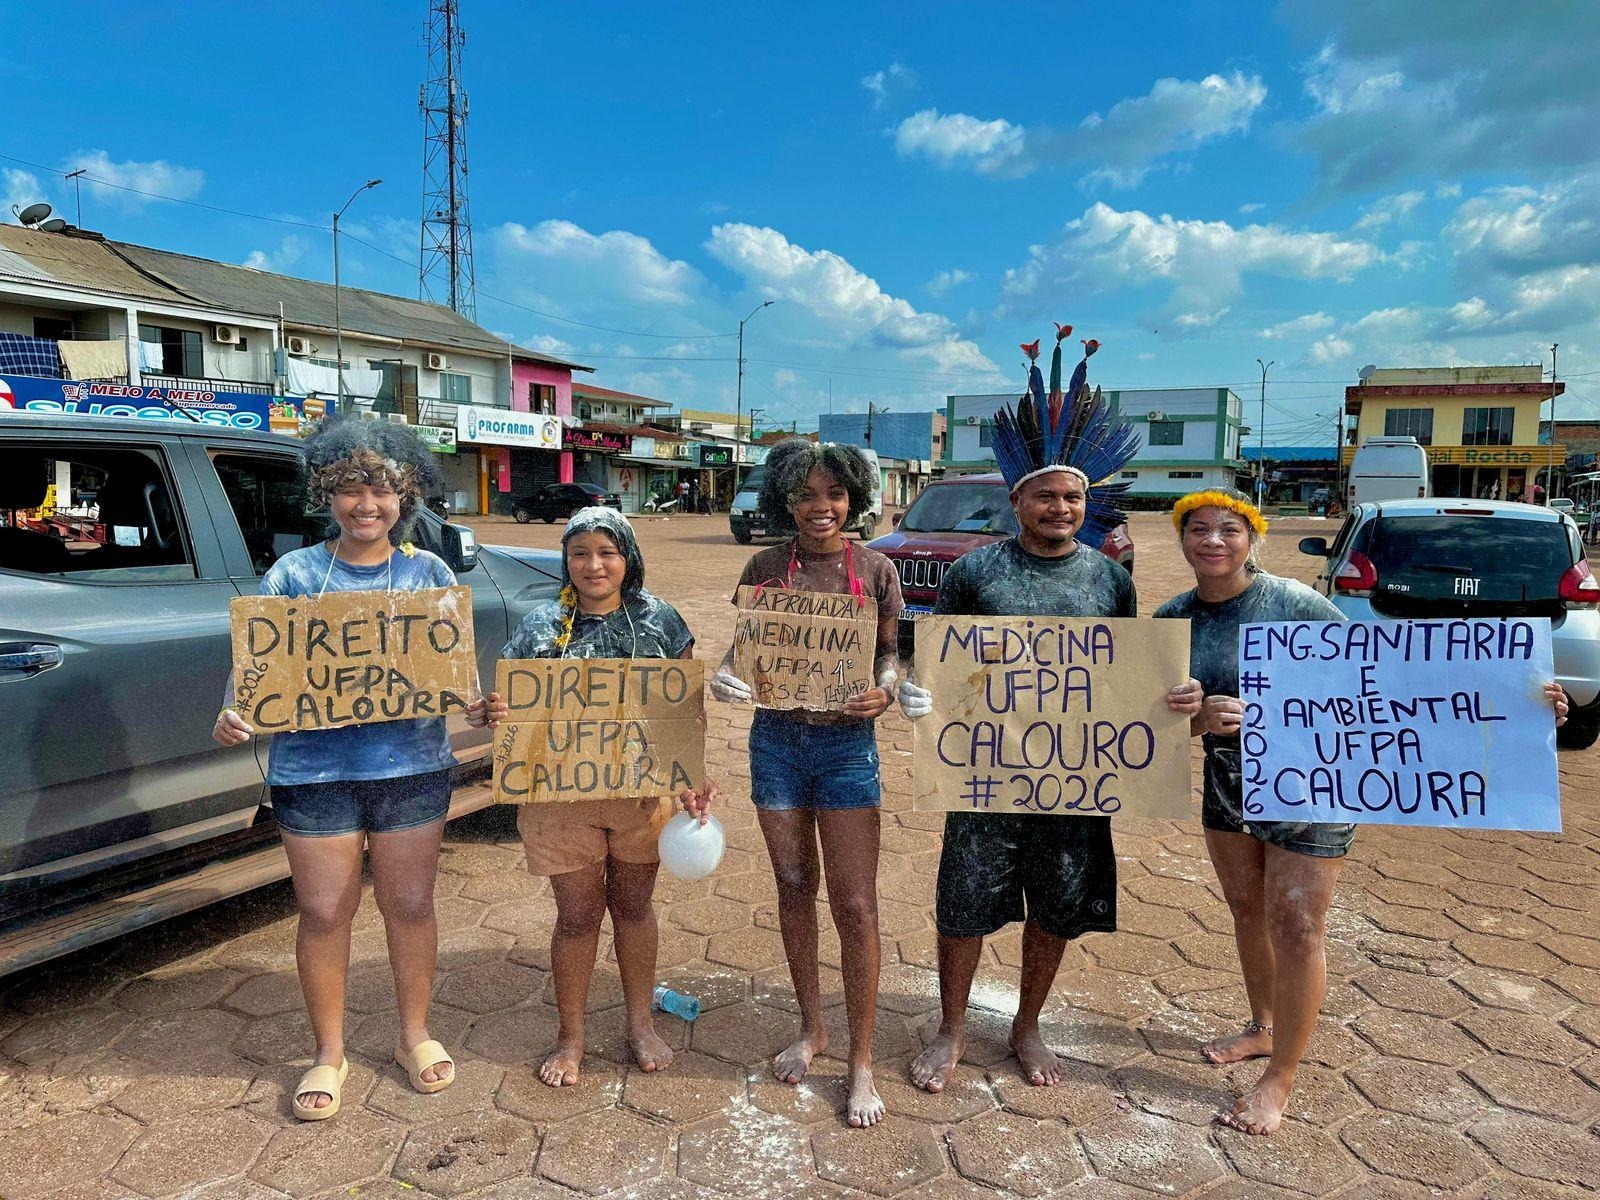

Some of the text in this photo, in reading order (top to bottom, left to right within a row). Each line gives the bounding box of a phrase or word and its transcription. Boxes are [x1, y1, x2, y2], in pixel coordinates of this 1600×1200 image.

[90, 384, 215, 402] MEIO A MEIO
[478, 419, 534, 436] PROFARMA
[1465, 449, 1533, 463] Rocha
[1454, 577, 1481, 596] FIAT
[739, 618, 862, 654] MEDICINA
[306, 664, 415, 697] UFPA
[756, 655, 824, 679] UFPA
[1360, 665, 1379, 697] E
[986, 666, 1092, 714] UFPA
[252, 690, 467, 728] CALOURA
[547, 719, 648, 754] UFPA
[937, 721, 1155, 771] CALOURO
[1314, 727, 1423, 765] UFPA
[500, 756, 693, 796] CALOURA
[1273, 767, 1486, 818] CALOURA
